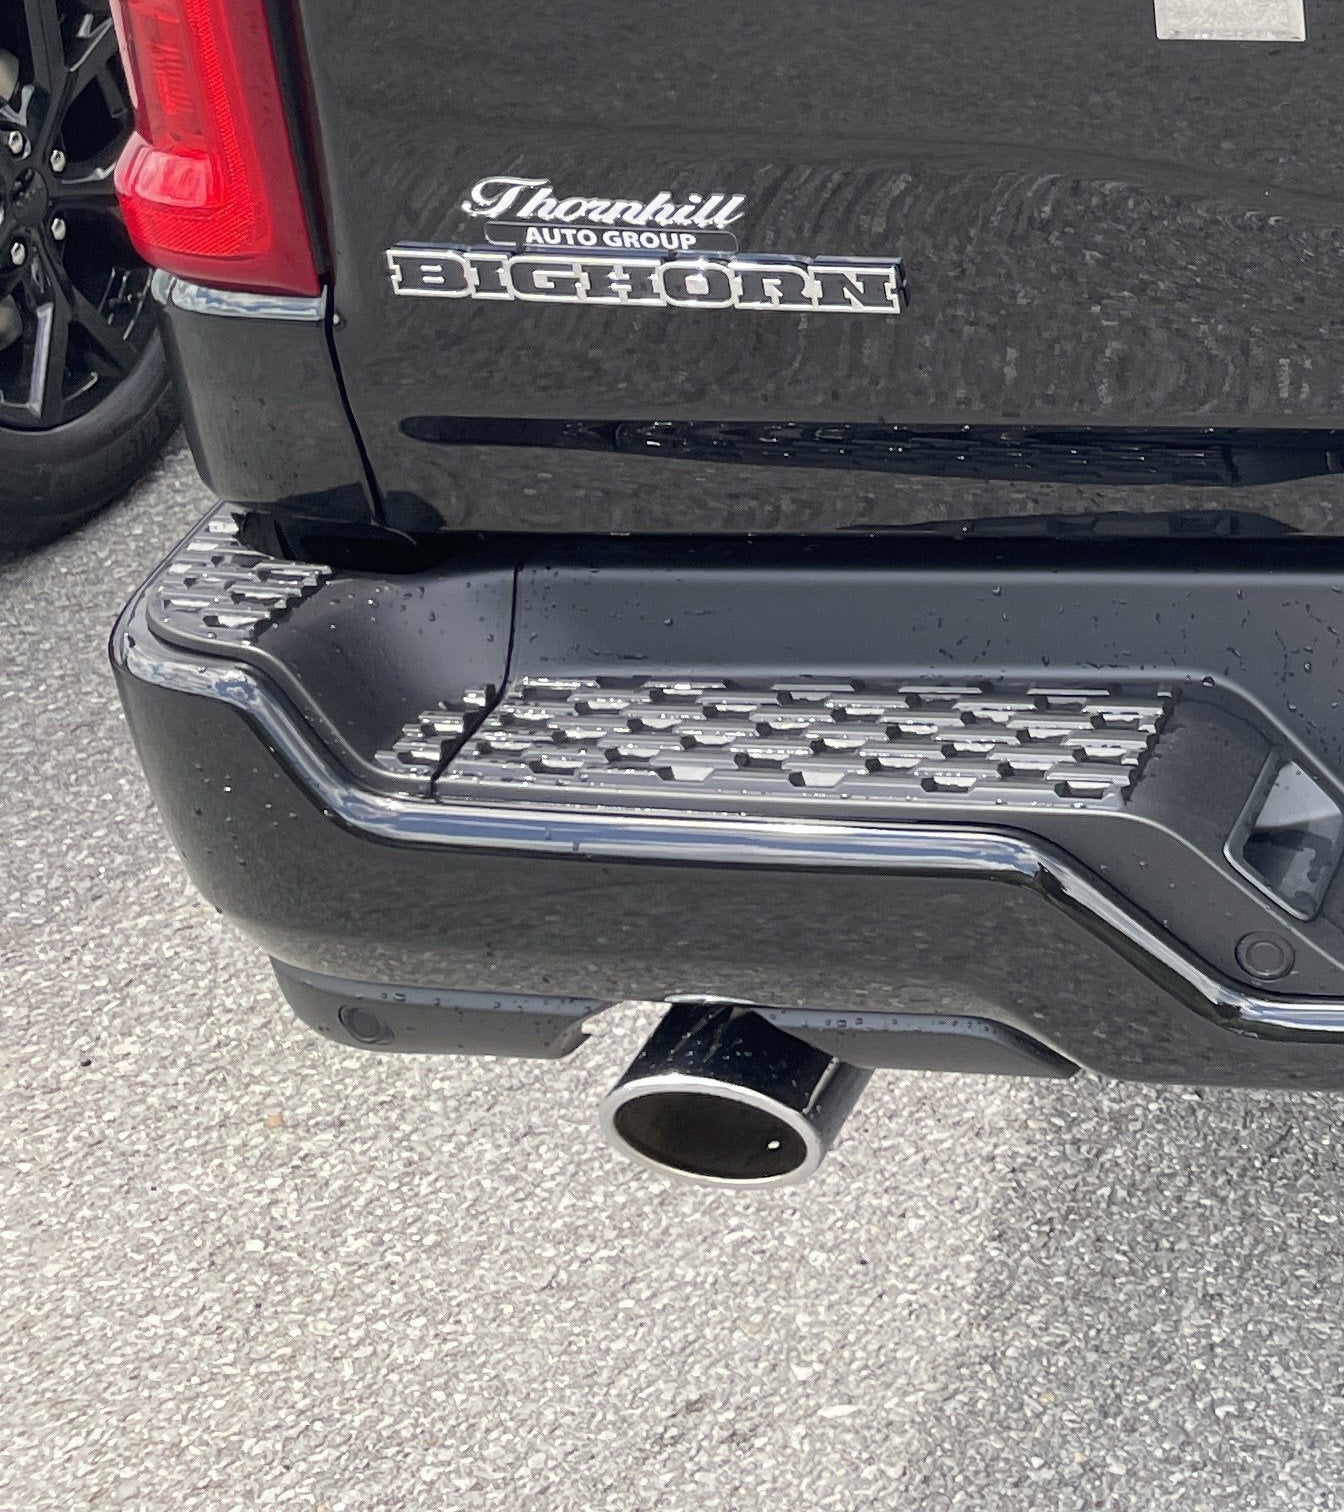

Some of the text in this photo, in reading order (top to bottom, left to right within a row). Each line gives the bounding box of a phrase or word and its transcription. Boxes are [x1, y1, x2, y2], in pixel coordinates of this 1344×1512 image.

[461, 175, 748, 228] Thornhill
[524, 225, 698, 252] AUTO GROUP
